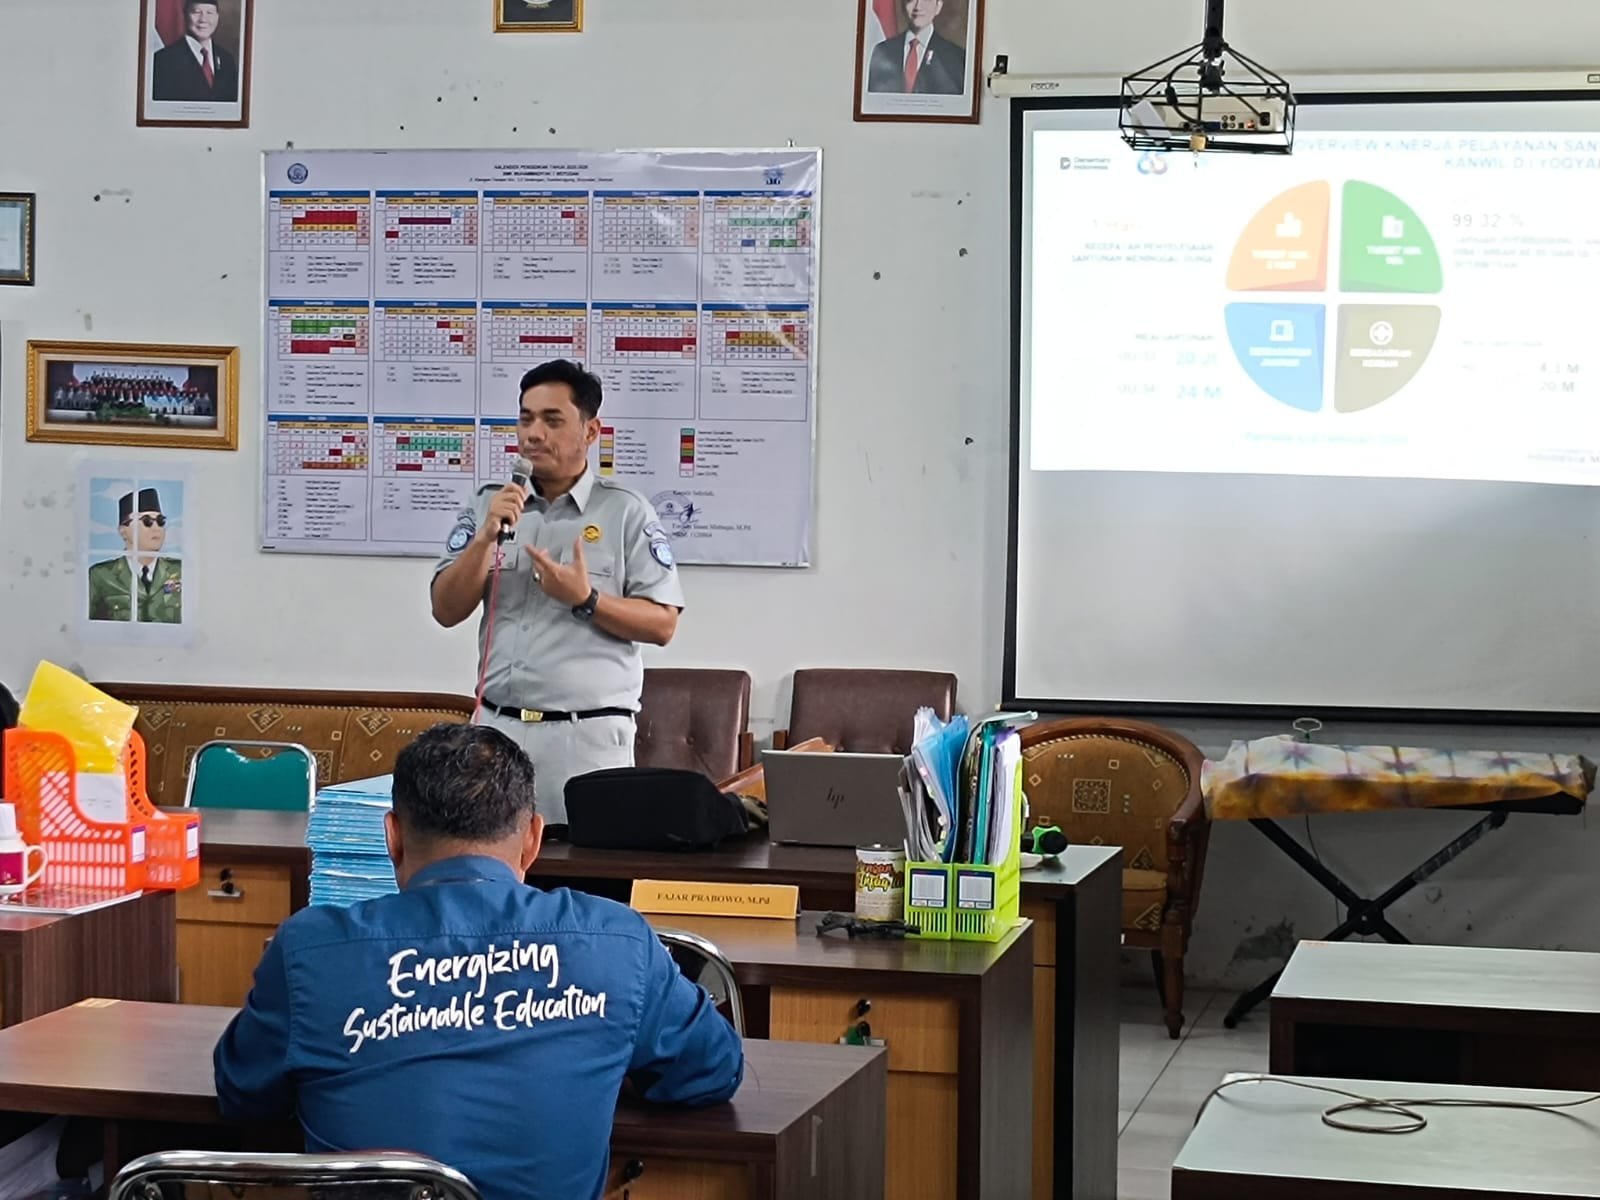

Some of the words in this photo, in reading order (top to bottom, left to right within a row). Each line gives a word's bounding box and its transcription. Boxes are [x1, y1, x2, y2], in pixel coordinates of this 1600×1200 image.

[1458, 139, 1558, 151] PELAYANAN
[826, 787, 844, 810] hp
[657, 892, 688, 902] FAJAR
[690, 893, 745, 905] PRABOWO,
[386, 940, 560, 999] Energizing
[343, 991, 485, 1054] Sustainable
[493, 984, 607, 1031] Education
